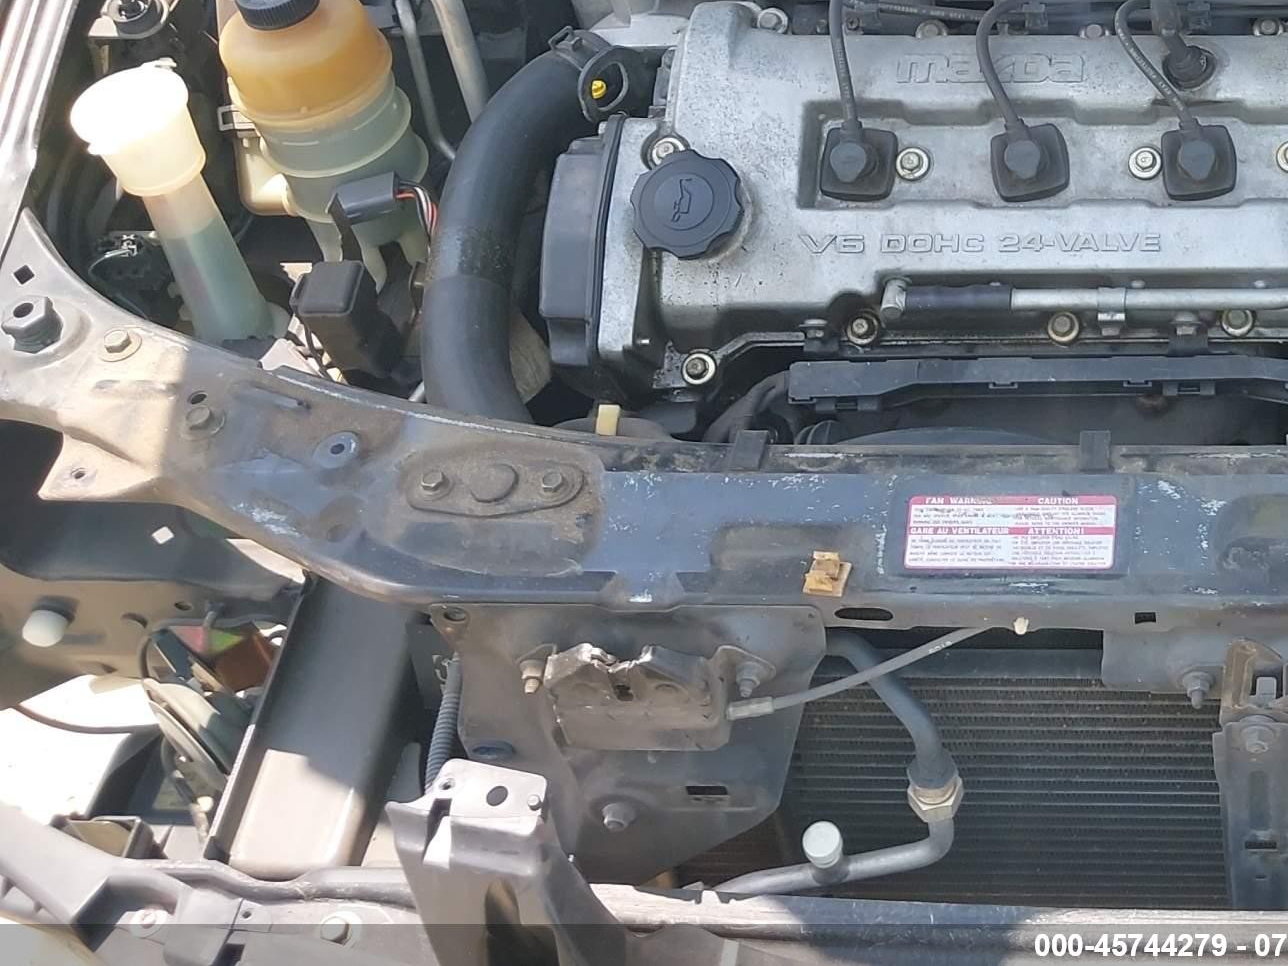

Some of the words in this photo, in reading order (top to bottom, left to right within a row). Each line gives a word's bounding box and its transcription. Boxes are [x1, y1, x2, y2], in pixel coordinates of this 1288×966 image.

[800, 233, 865, 254] V6
[880, 233, 985, 254] DOHC
[998, 233, 1161, 253] 24-VALVE
[925, 497, 945, 505] FAN
[1037, 497, 1079, 505] CAUTION
[910, 527, 934, 535] GARE
[936, 527, 949, 535] AU
[951, 527, 1009, 535] VENTILATEUR
[1027, 527, 1085, 535] ATTENTION!
